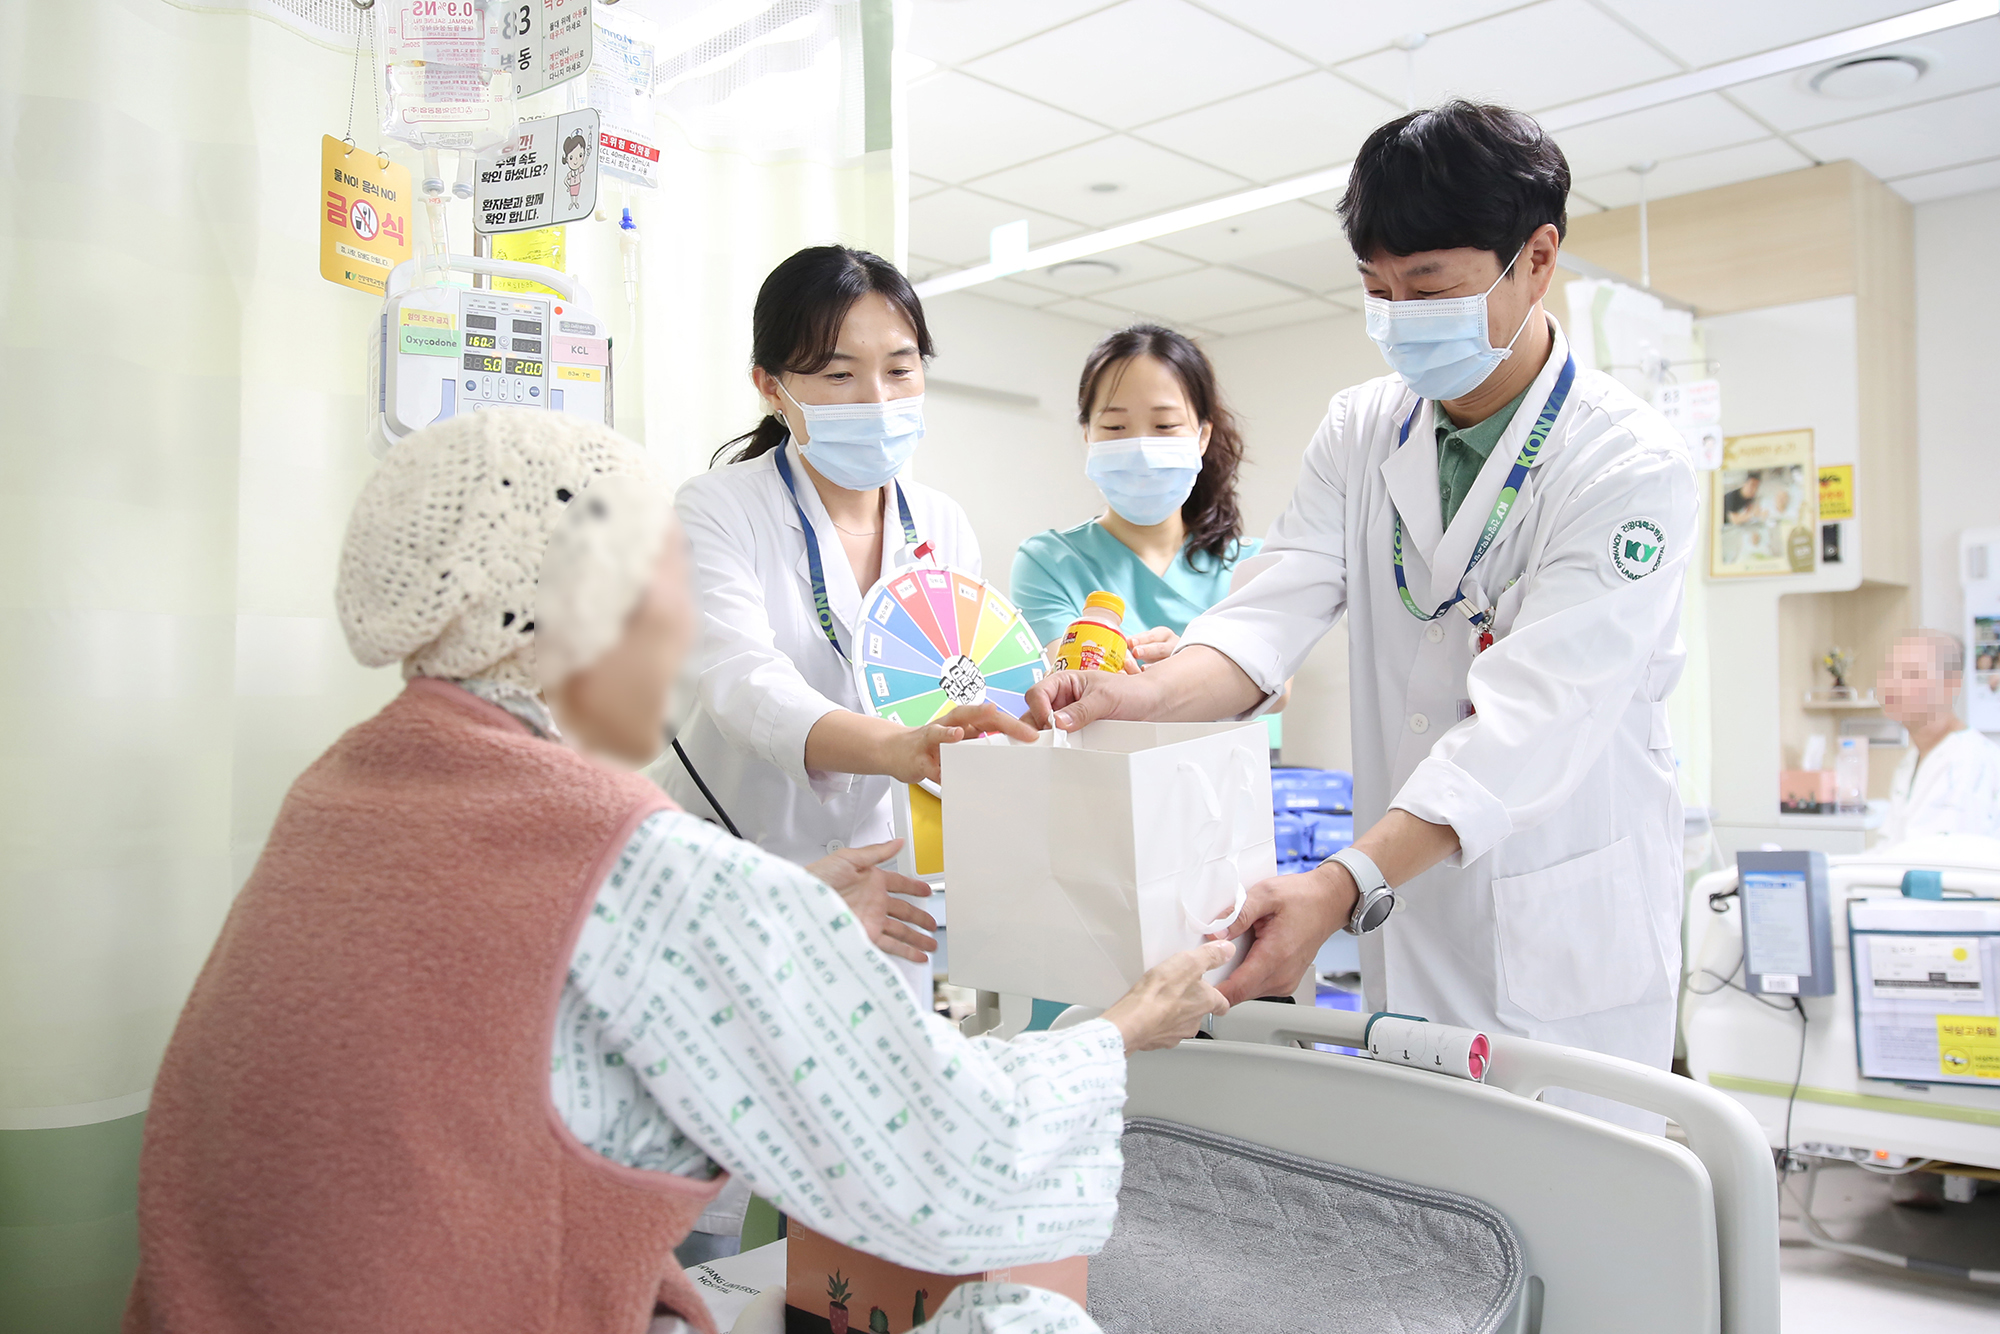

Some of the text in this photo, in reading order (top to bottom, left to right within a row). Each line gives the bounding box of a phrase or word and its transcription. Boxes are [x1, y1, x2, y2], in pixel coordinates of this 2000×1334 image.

[566, 20, 581, 32] 마세요
[549, 61, 581, 81] 다니지 마세요
[600, 134, 651, 158] 고위험 의약품
[519, 151, 537, 166] 속도
[599, 155, 617, 166] 반드시
[481, 163, 549, 184] 확인 하셨나요?
[343, 173, 359, 189] NO!
[362, 180, 379, 198] 음식
[380, 187, 397, 202] NO!
[482, 192, 545, 212] 환자분과 함께
[326, 190, 404, 247] 금 식
[485, 208, 540, 226] 확인 합니다.
[422, 314, 436, 323] 조작
[436, 316, 449, 325] 금지
[405, 335, 458, 347] Oxycodone
[571, 345, 589, 355] KCL
[483, 358, 502, 372] 5.0
[514, 360, 543, 376] 20.0
